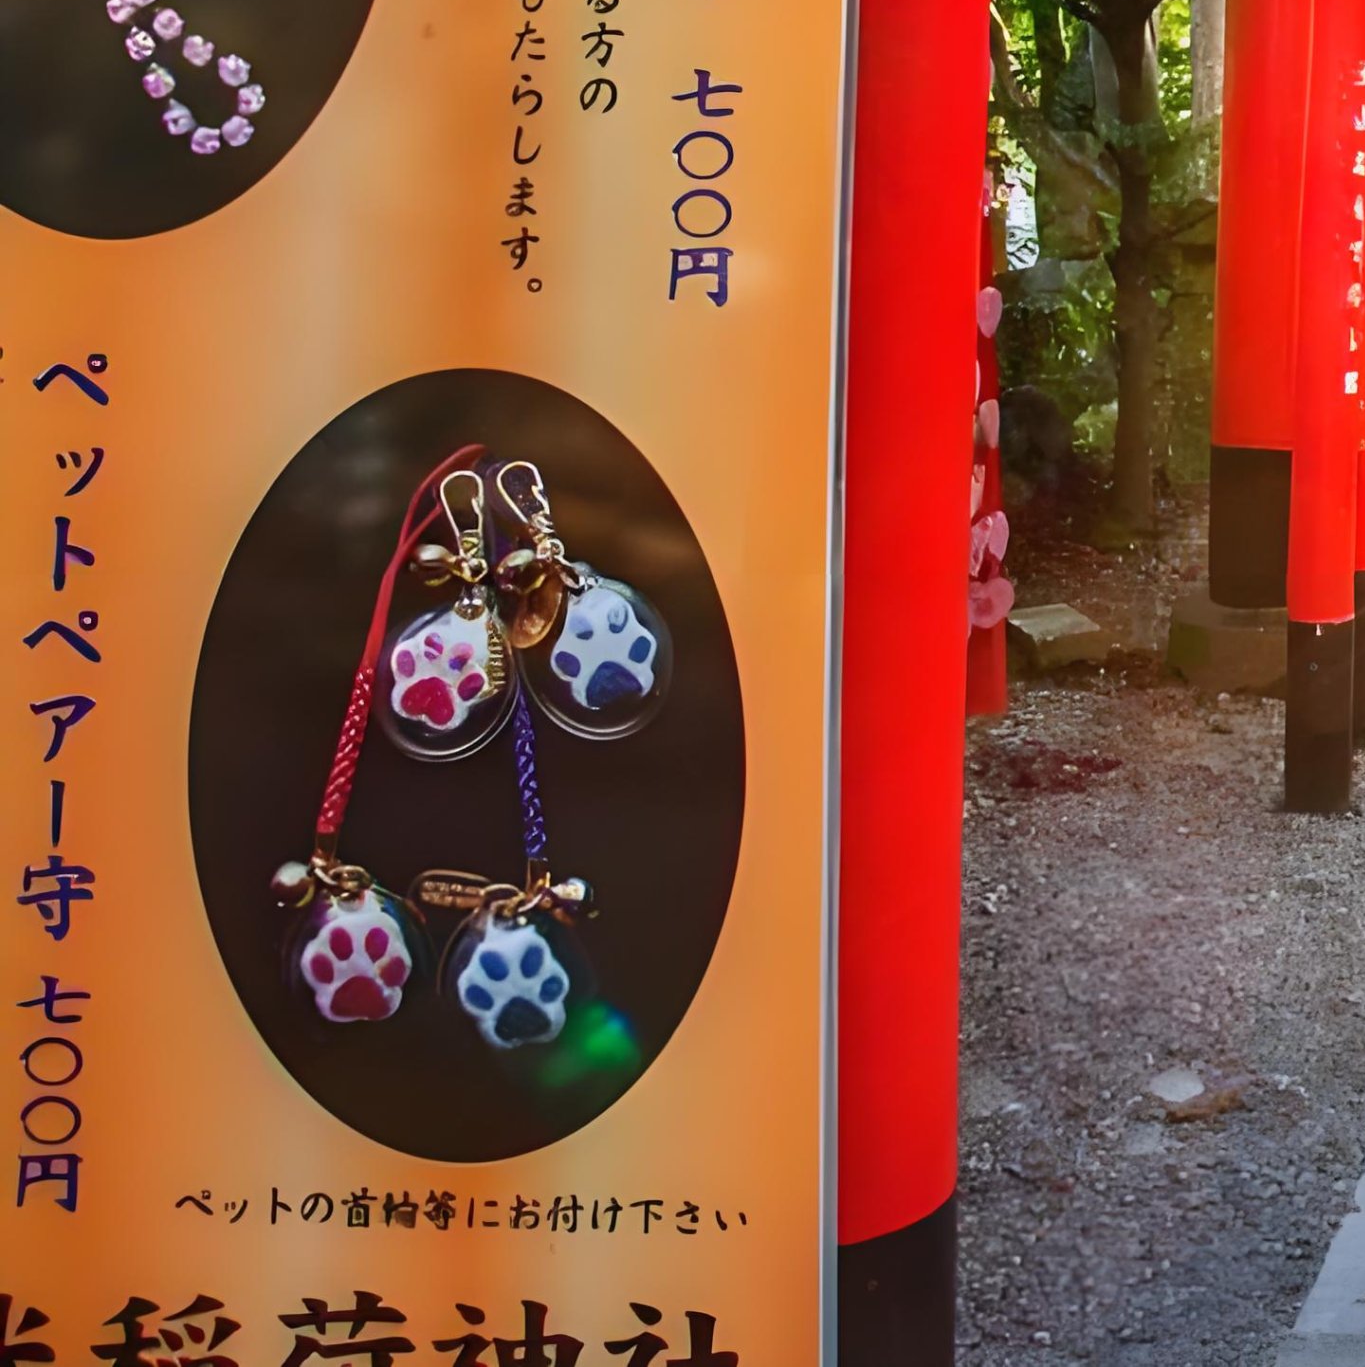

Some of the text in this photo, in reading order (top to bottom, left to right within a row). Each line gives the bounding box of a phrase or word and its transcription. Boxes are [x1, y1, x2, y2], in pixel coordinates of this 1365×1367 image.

[15, 353, 110, 942] ペットペアー守
[174, 1186, 748, 1235] ペットの首輪等にお付け下さい
